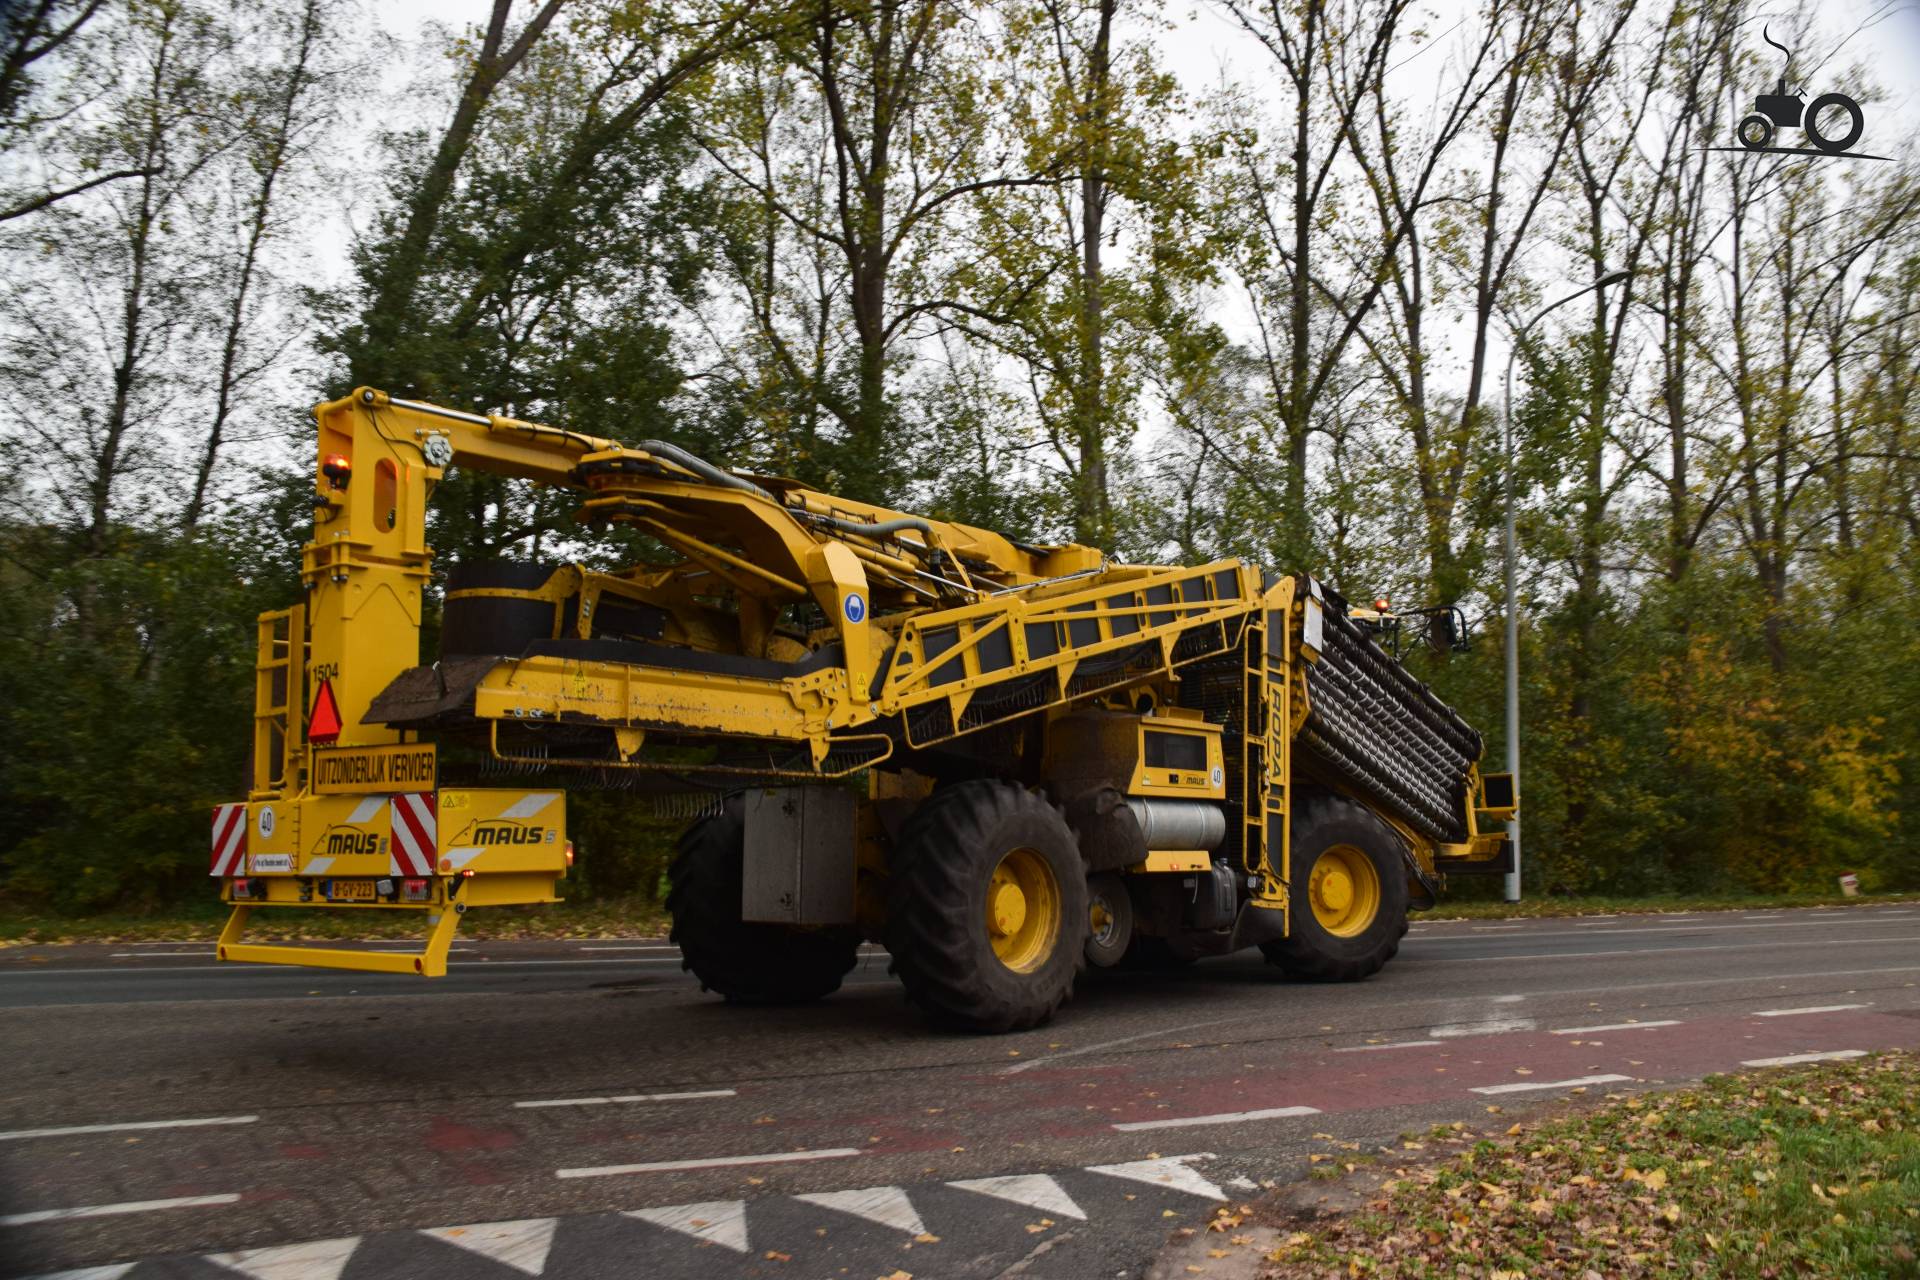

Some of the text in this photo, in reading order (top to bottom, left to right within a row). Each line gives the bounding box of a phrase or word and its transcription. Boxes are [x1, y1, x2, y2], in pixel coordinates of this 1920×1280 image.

[313, 662, 339, 682] 1504
[1272, 688, 1280, 777] ROPA
[318, 752, 434, 785] UITZONDERLIJK VERVOER
[1213, 769, 1220, 784] 40
[261, 812, 272, 832] 40
[327, 833, 379, 855] MAUS
[472, 826, 544, 846] MAUS
